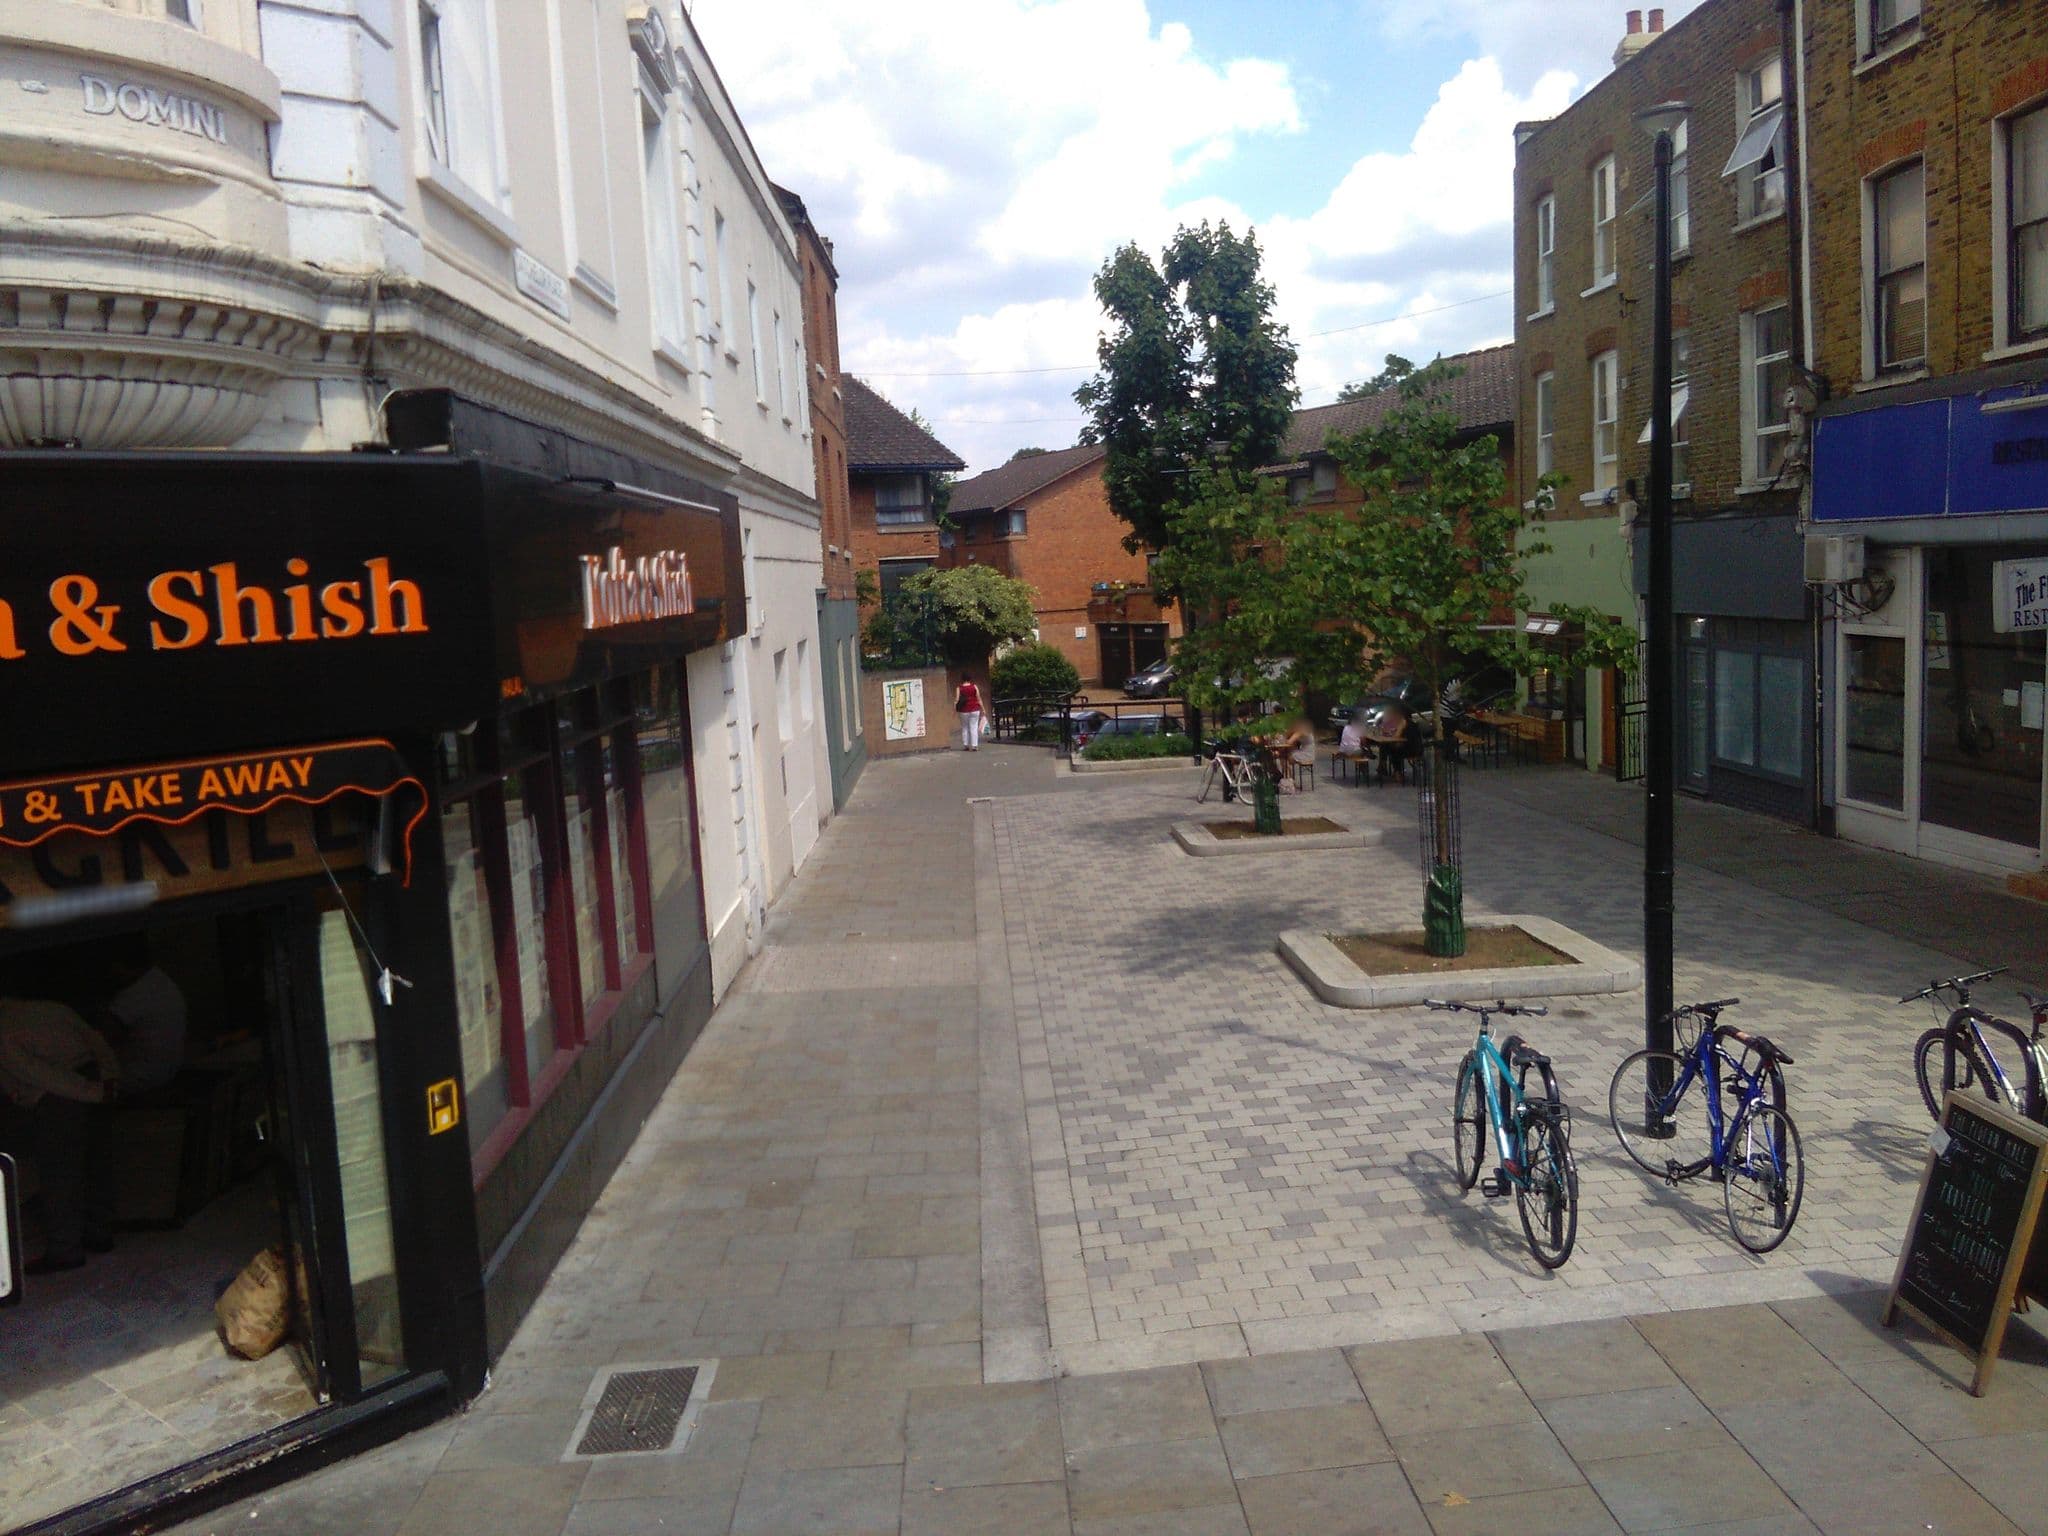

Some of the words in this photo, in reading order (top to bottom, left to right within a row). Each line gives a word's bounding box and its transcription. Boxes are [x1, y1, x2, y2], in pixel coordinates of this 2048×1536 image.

[80, 74, 227, 144] DOMINI
[48, 574, 127, 656] &
[146, 556, 429, 651] Shish
[2015, 582, 2035, 609] The
[22, 789, 63, 824] &
[74, 772, 183, 815] TAKE
[197, 756, 315, 800] AWAY
